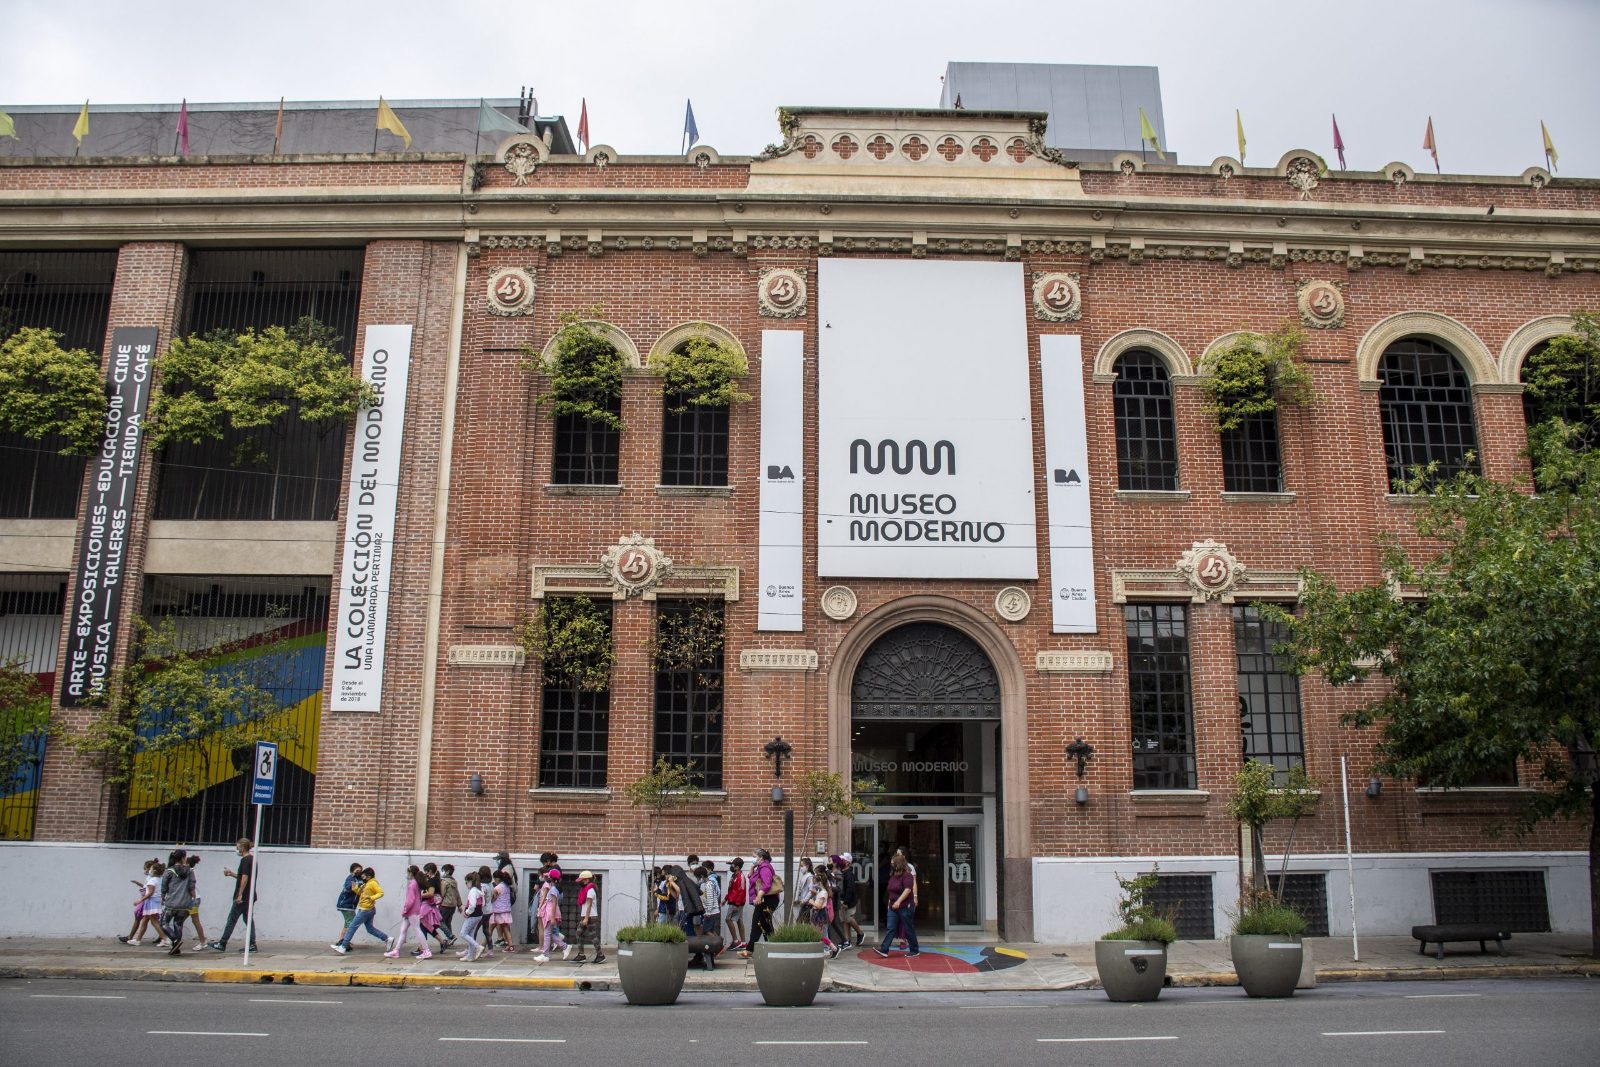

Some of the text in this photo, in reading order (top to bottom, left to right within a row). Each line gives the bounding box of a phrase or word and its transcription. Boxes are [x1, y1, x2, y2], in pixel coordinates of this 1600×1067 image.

[103, 508, 127, 588] TALLERES
[119, 414, 141, 478] TIENDA
[133, 344, 150, 382] CAFÉ
[768, 465, 794, 480] BA
[1054, 469, 1081, 483] BA
[344, 348, 389, 670] LA COLECCIÓN DEL MODERNO
[850, 492, 957, 515] MUSEO
[68, 344, 132, 696] ARTE EXPOSICIONES EDUCACIÓN CINE
[850, 520, 1005, 543] MODERNO
[364, 532, 383, 670] UNA LLAMARADA PERTINAZ
[853, 761, 968, 772] MUSEO MODERNO
